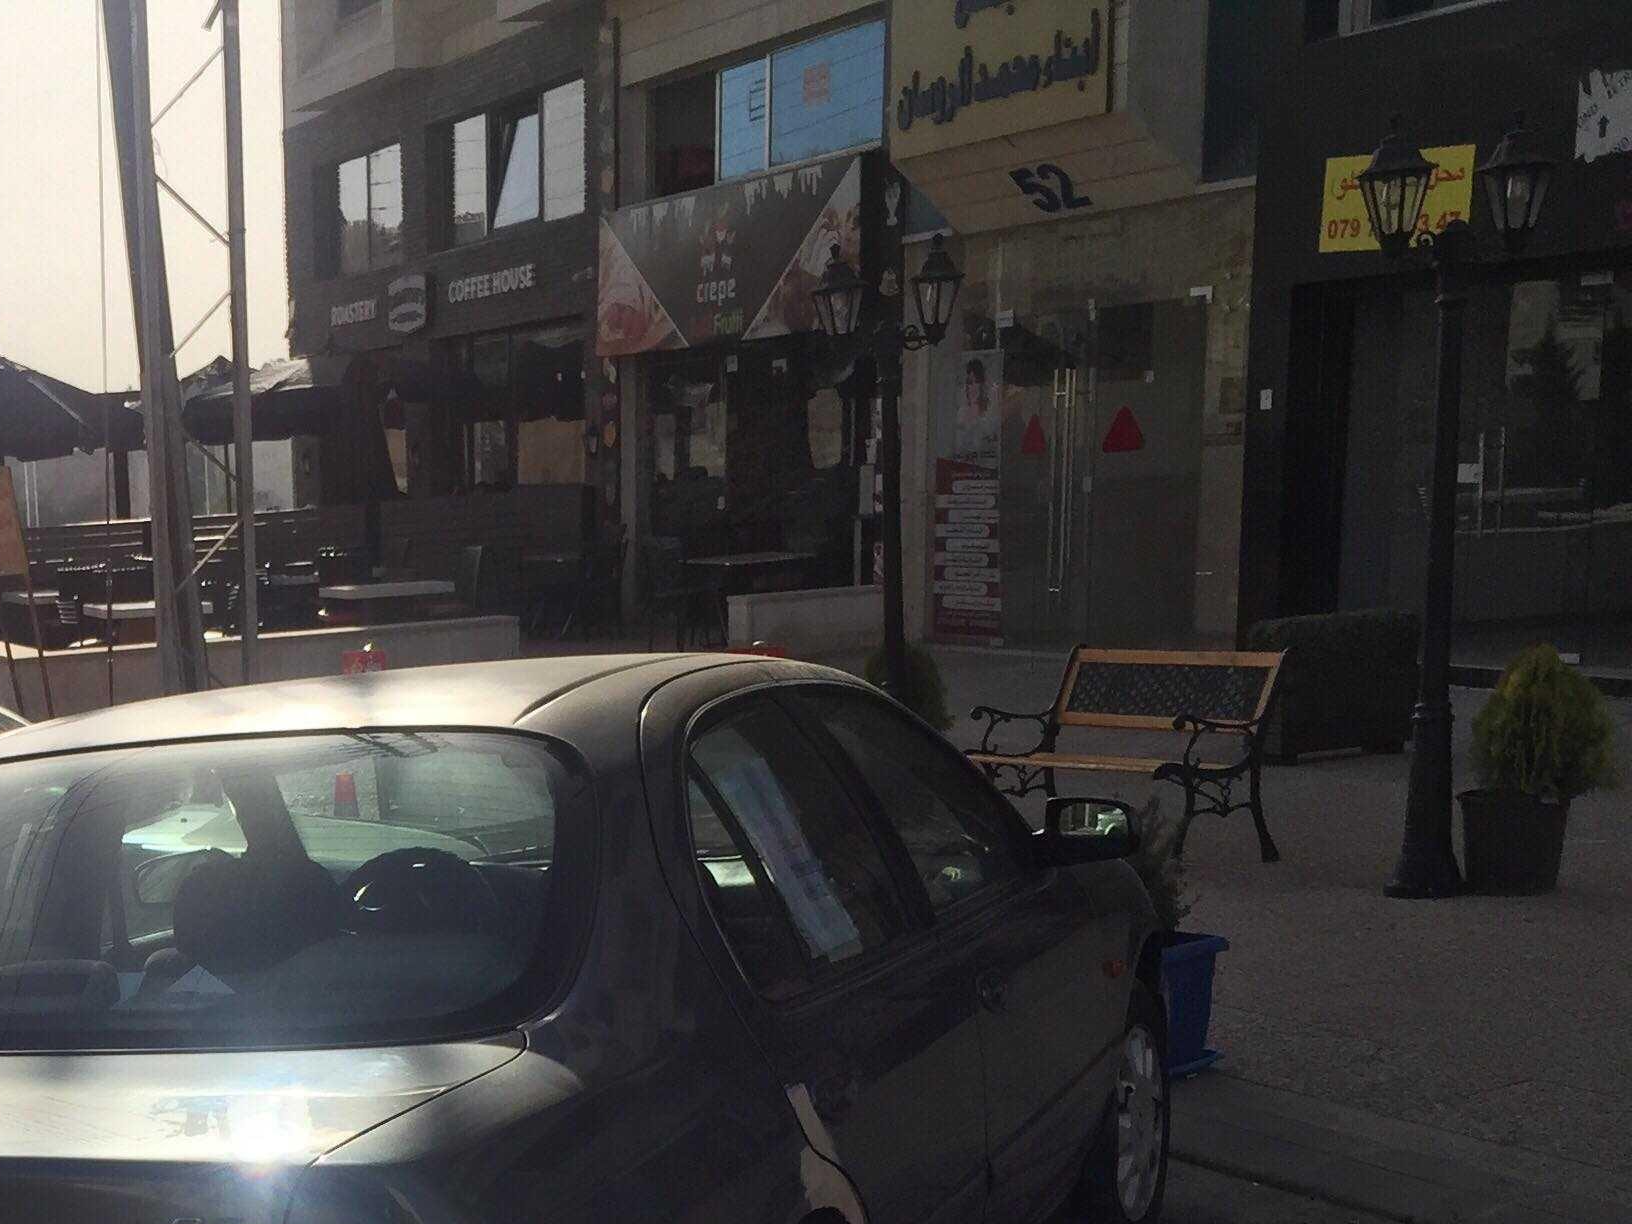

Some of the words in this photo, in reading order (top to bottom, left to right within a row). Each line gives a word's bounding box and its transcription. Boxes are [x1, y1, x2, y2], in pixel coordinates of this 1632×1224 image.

[1008, 163, 1093, 212] 52
[1327, 218, 1361, 239] 079
[447, 271, 493, 304] COFFEE
[494, 263, 537, 297] HOUSE
